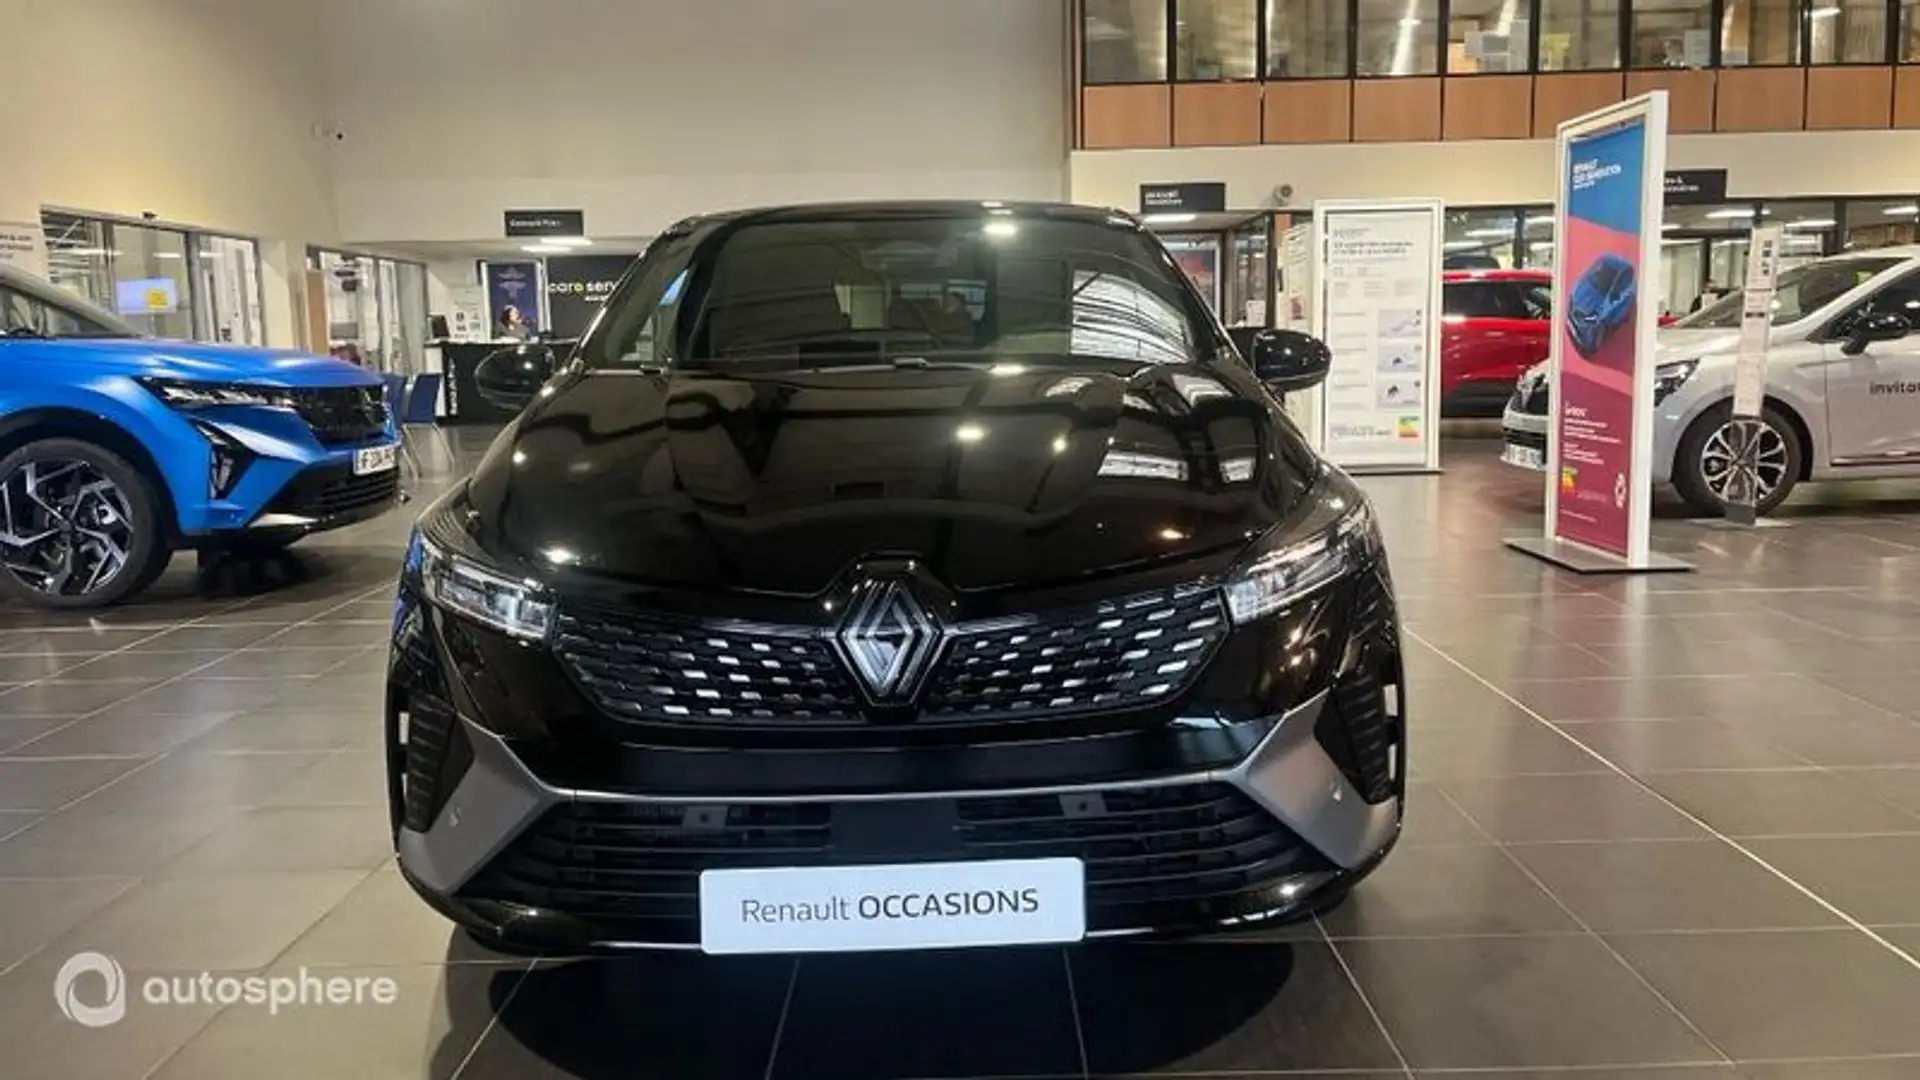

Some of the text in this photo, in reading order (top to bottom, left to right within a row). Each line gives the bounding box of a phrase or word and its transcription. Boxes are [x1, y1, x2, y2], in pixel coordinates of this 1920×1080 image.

[548, 281, 584, 293] care
[741, 888, 1039, 923] Renault OCCASIONS
